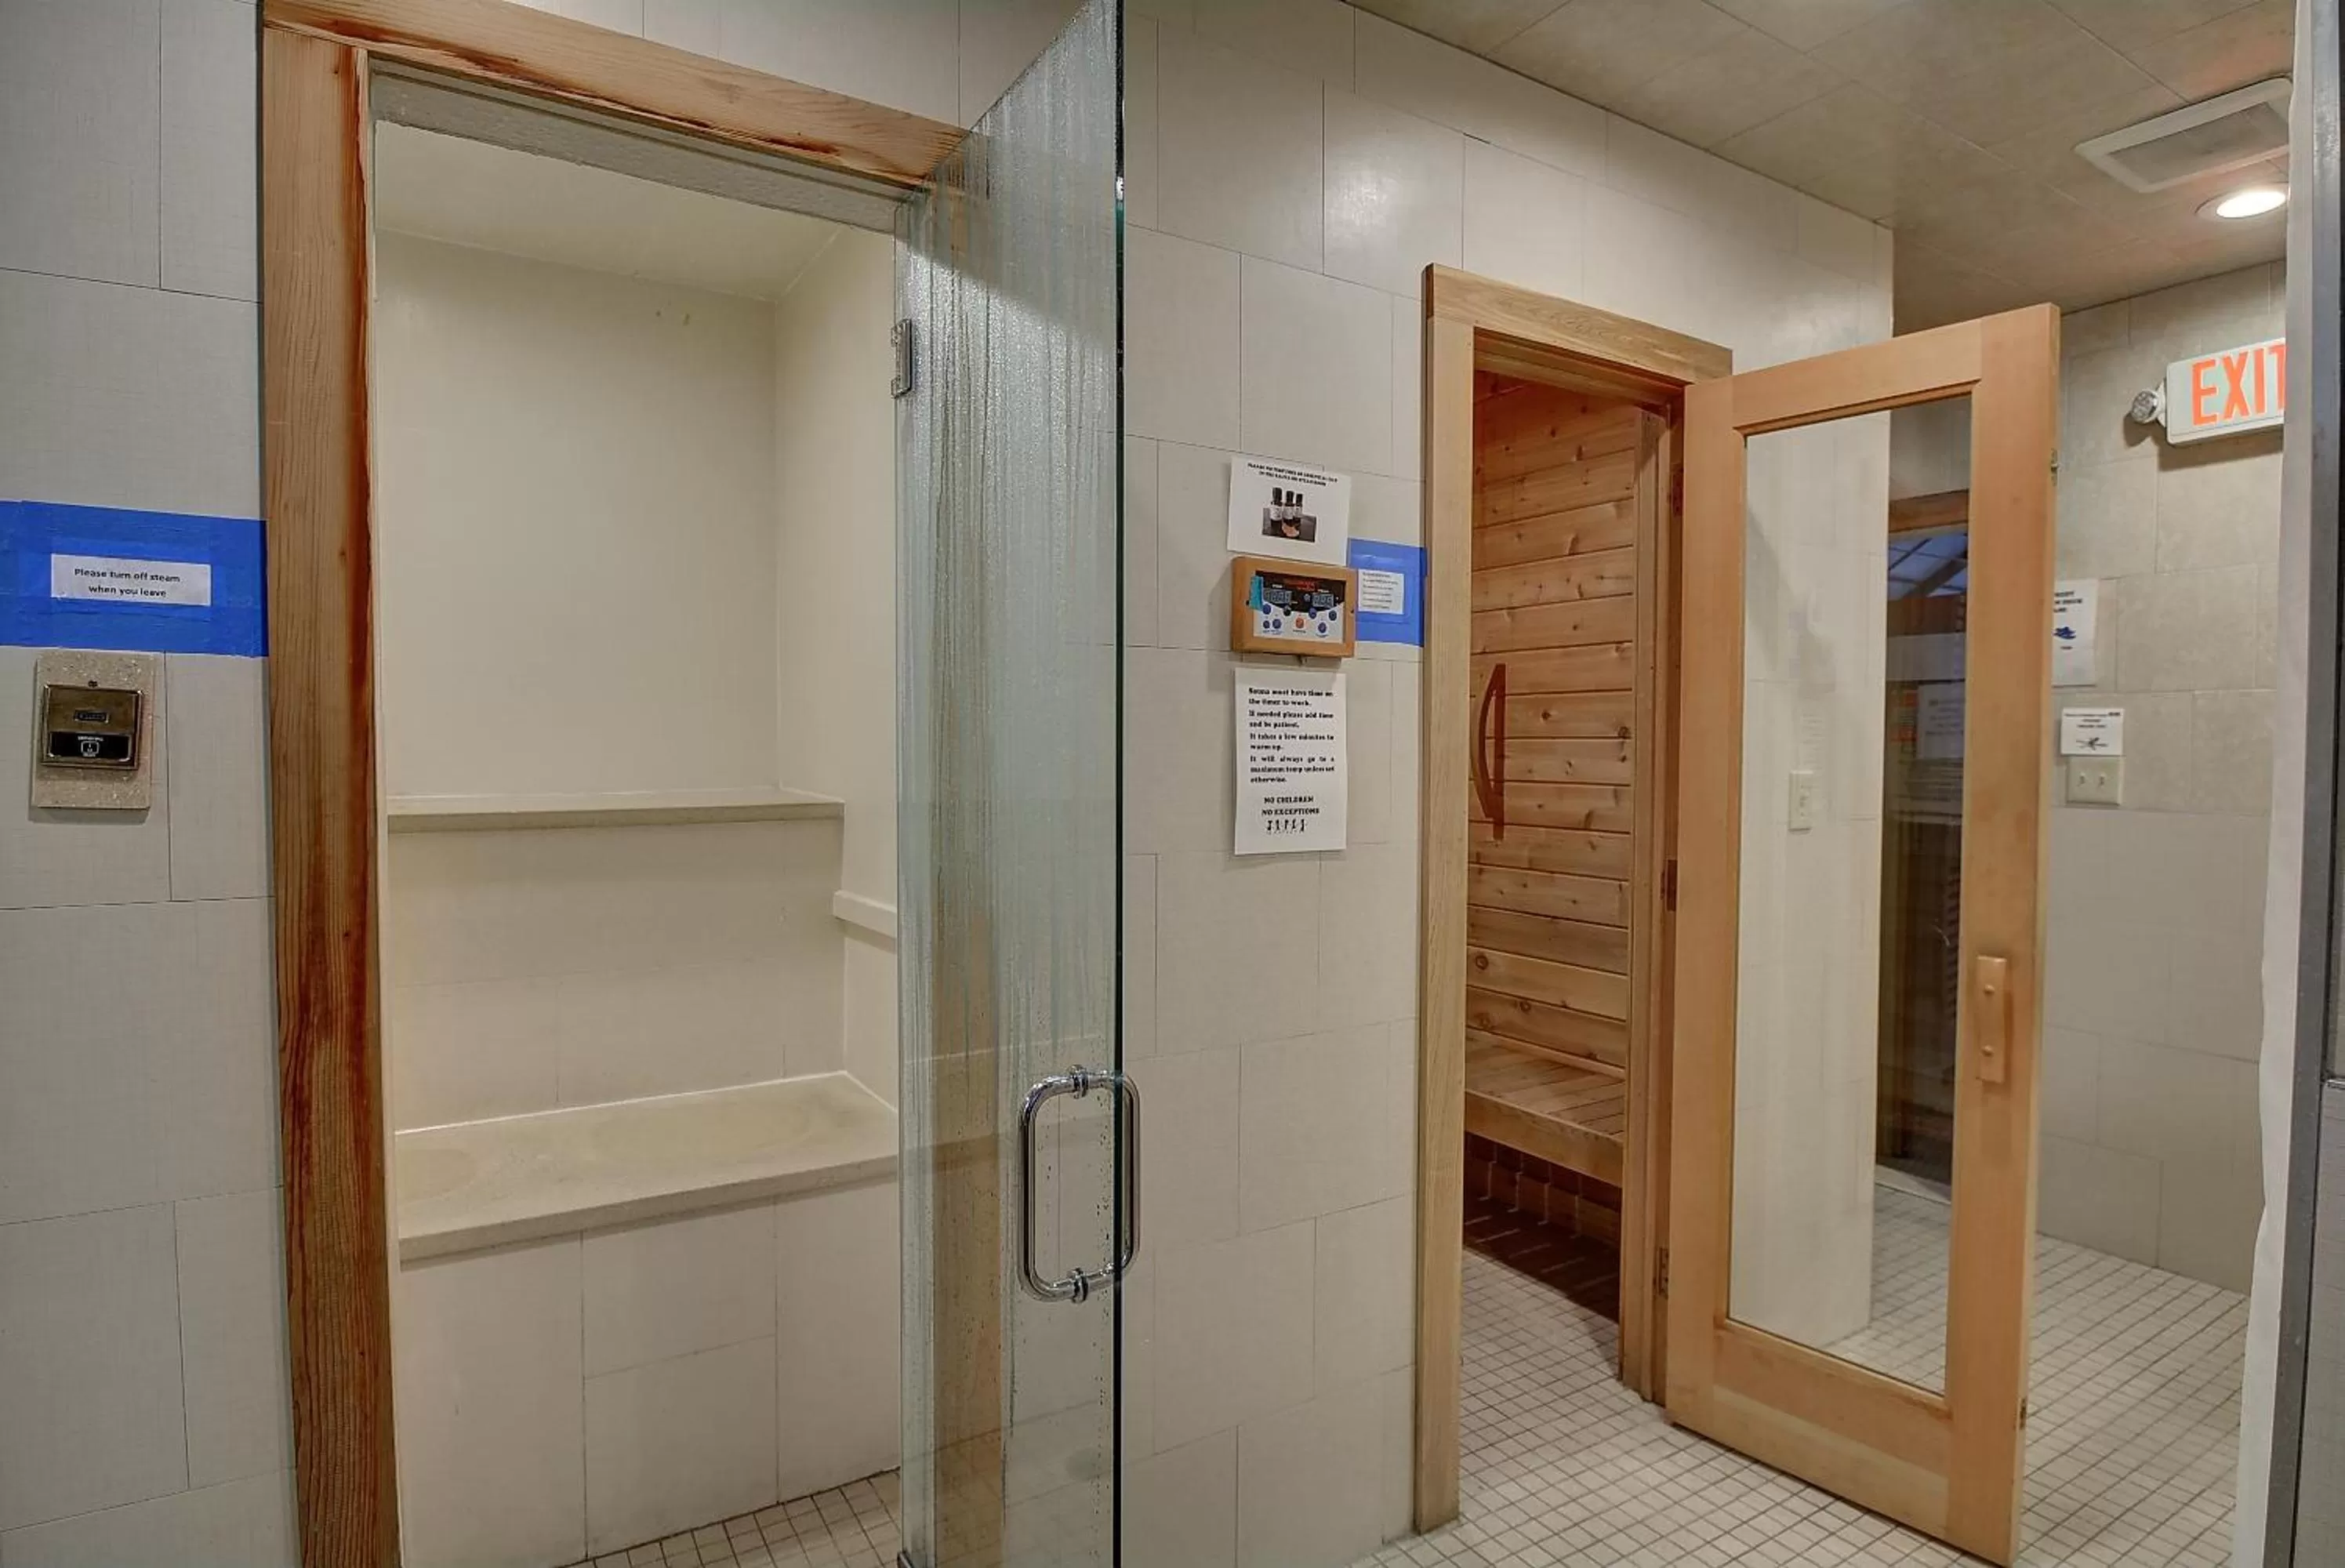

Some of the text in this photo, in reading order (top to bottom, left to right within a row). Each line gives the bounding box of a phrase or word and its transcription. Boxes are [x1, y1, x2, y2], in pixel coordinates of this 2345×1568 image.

[2192, 344, 2286, 426] EXIT
[74, 568, 107, 578] Please
[133, 572, 147, 581] off
[150, 574, 180, 583] steam
[89, 585, 117, 594] when
[140, 588, 166, 597] leave
[1280, 755, 1303, 764] always
